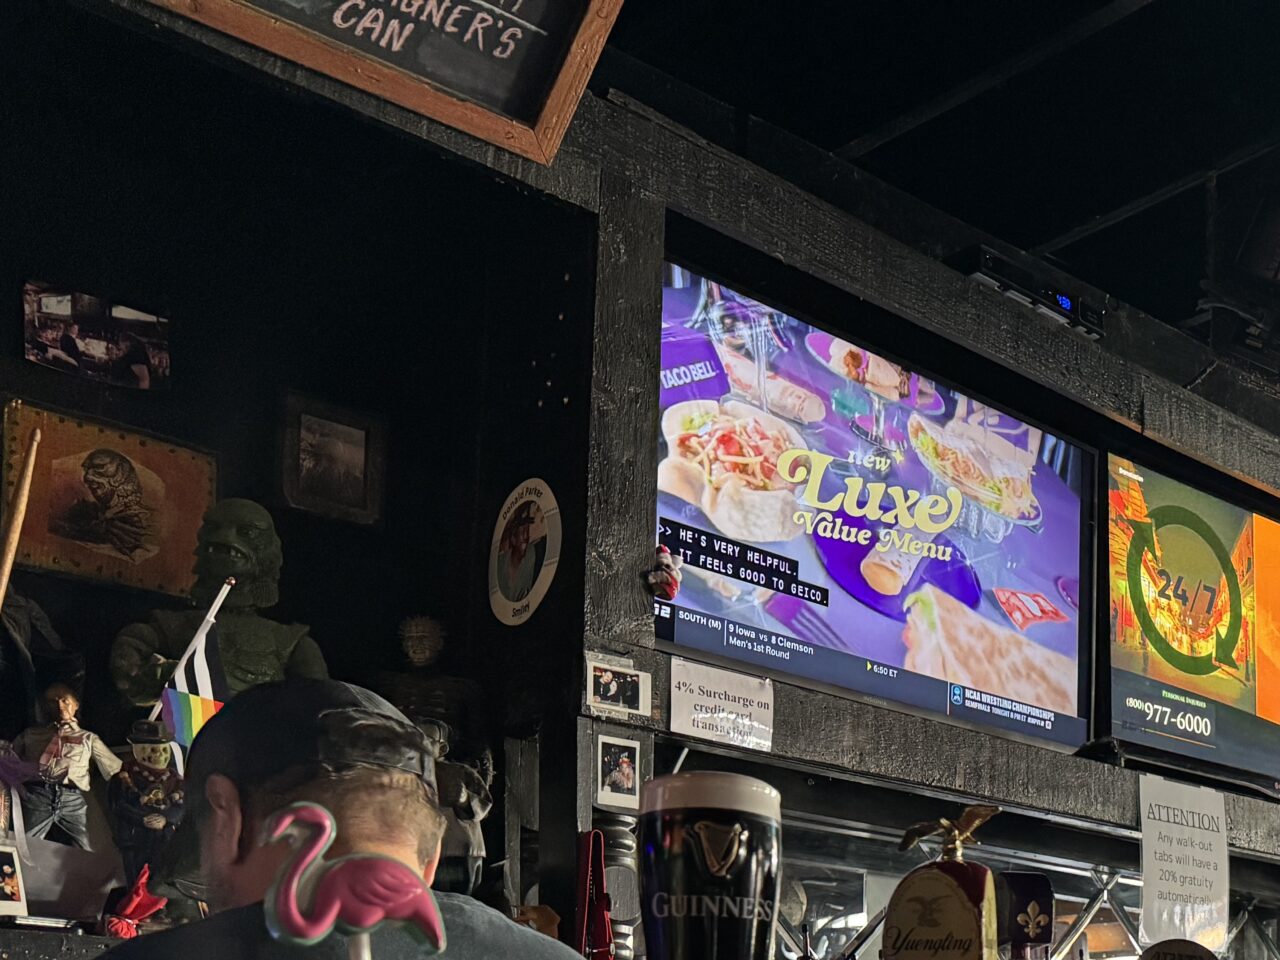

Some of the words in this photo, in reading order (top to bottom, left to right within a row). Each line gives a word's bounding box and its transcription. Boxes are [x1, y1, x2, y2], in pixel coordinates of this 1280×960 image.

[332, 0, 415, 52] CAN
[660, 366, 692, 389] TACO
[688, 361, 716, 381] BELL
[847, 450, 892, 472] new
[776, 448, 963, 534] Luxe
[793, 511, 873, 546] Value
[875, 528, 953, 562] Menu
[679, 528, 707, 548] HE'S
[714, 539, 741, 558] VERY
[747, 550, 798, 577] HELPFUL.
[699, 555, 733, 575] FEELS
[739, 567, 766, 585] GOOD
[772, 576, 785, 590] TO
[790, 582, 827, 604] GEICO.
[1156, 568, 1218, 616] 24/7
[678, 611, 707, 626] SOUTH
[708, 618, 722, 631] (M)
[729, 635, 752, 650] Men's
[753, 642, 765, 653] 1st
[765, 646, 790, 660] Round
[735, 625, 756, 639] Iowa
[759, 633, 768, 642] vs
[778, 637, 814, 655] Clemson
[888, 668, 898, 679] ET
[674, 680, 694, 695] 4%
[698, 685, 755, 708] Surcharge
[757, 700, 770, 711] on
[1144, 702, 1211, 737] 977-6000
[1147, 803, 1221, 833] ATTENTION
[1157, 831, 1174, 848] Any
[1176, 836, 1213, 853] walk-out
[1154, 850, 1173, 864] tabs
[1175, 853, 1190, 867] will
[1192, 856, 1212, 869] have
[1159, 868, 1178, 883] 20%
[1179, 874, 1214, 890] gratuity
[651, 892, 774, 923] GUINNESS
[885, 926, 973, 957] Yuengling
